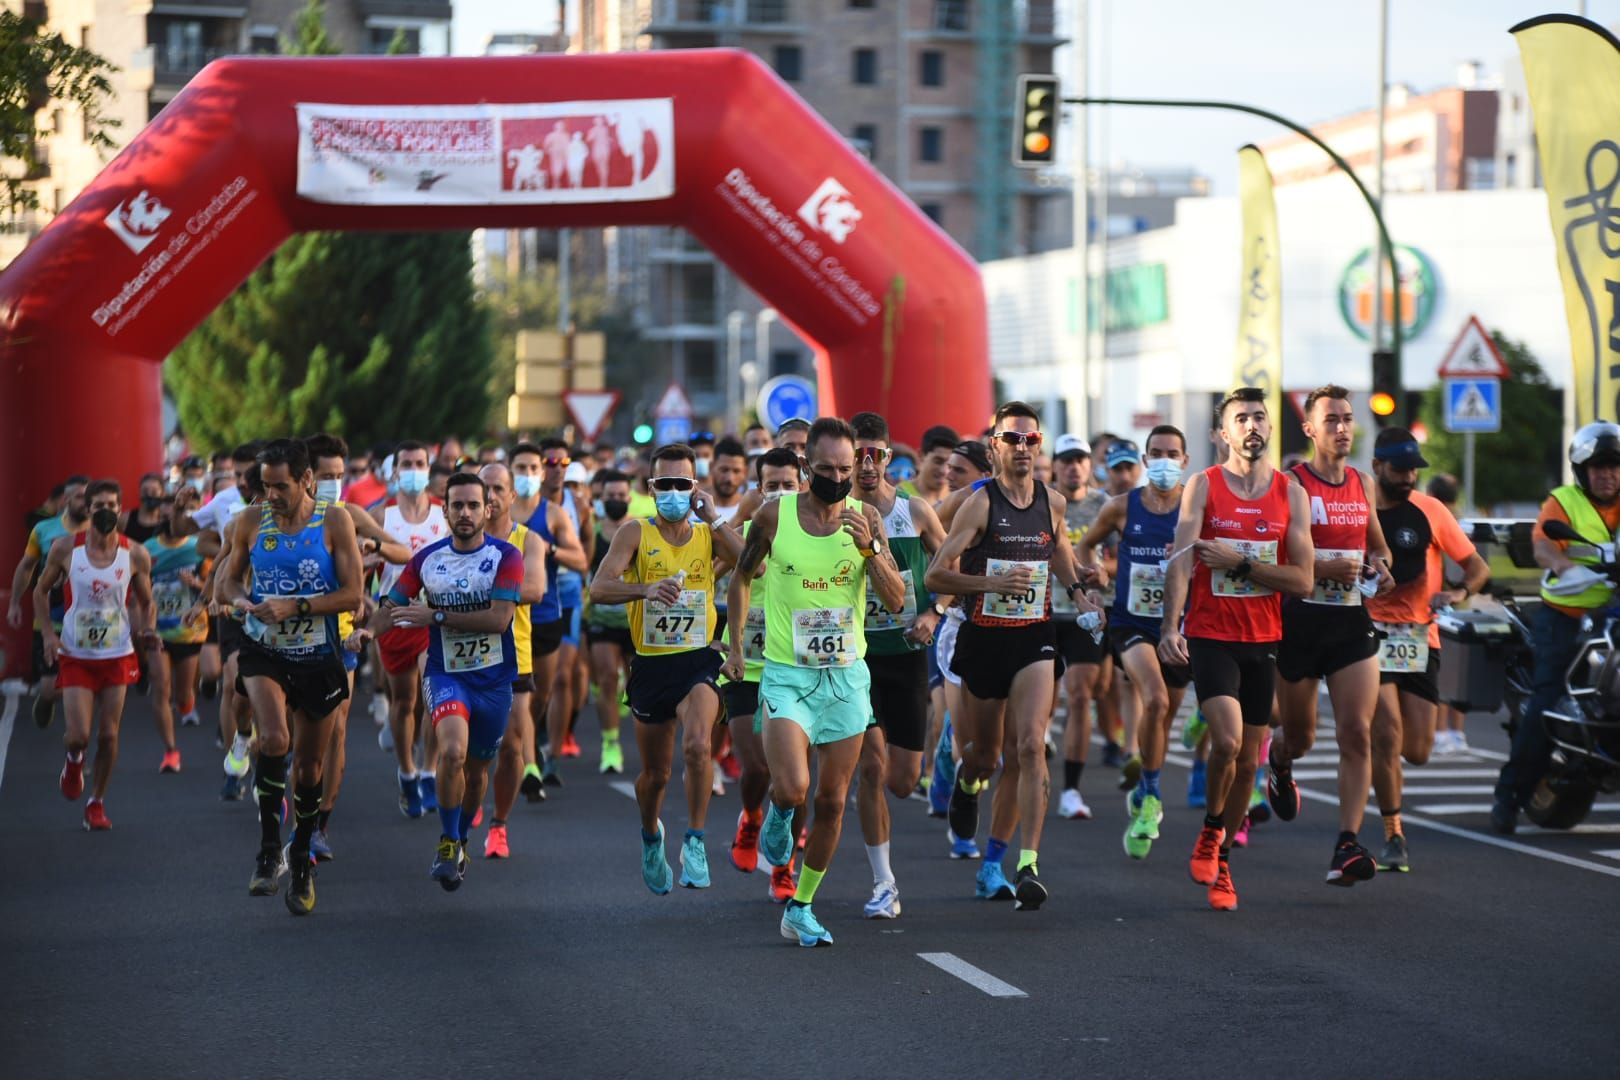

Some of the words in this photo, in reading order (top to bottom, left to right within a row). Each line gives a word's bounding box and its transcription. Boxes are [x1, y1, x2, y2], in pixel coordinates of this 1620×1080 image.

[725, 167, 804, 245] Diputación
[799, 239, 823, 262] de
[91, 249, 172, 327] Diputación
[168, 231, 190, 255] de
[185, 175, 248, 234] Córdoba
[803, 577, 829, 589] Barin
[278, 619, 314, 635] 172
[655, 616, 695, 633] 477
[88, 627, 109, 641] 87
[454, 638, 490, 658] 275
[807, 636, 846, 654] 461
[1386, 644, 1418, 659] 203
